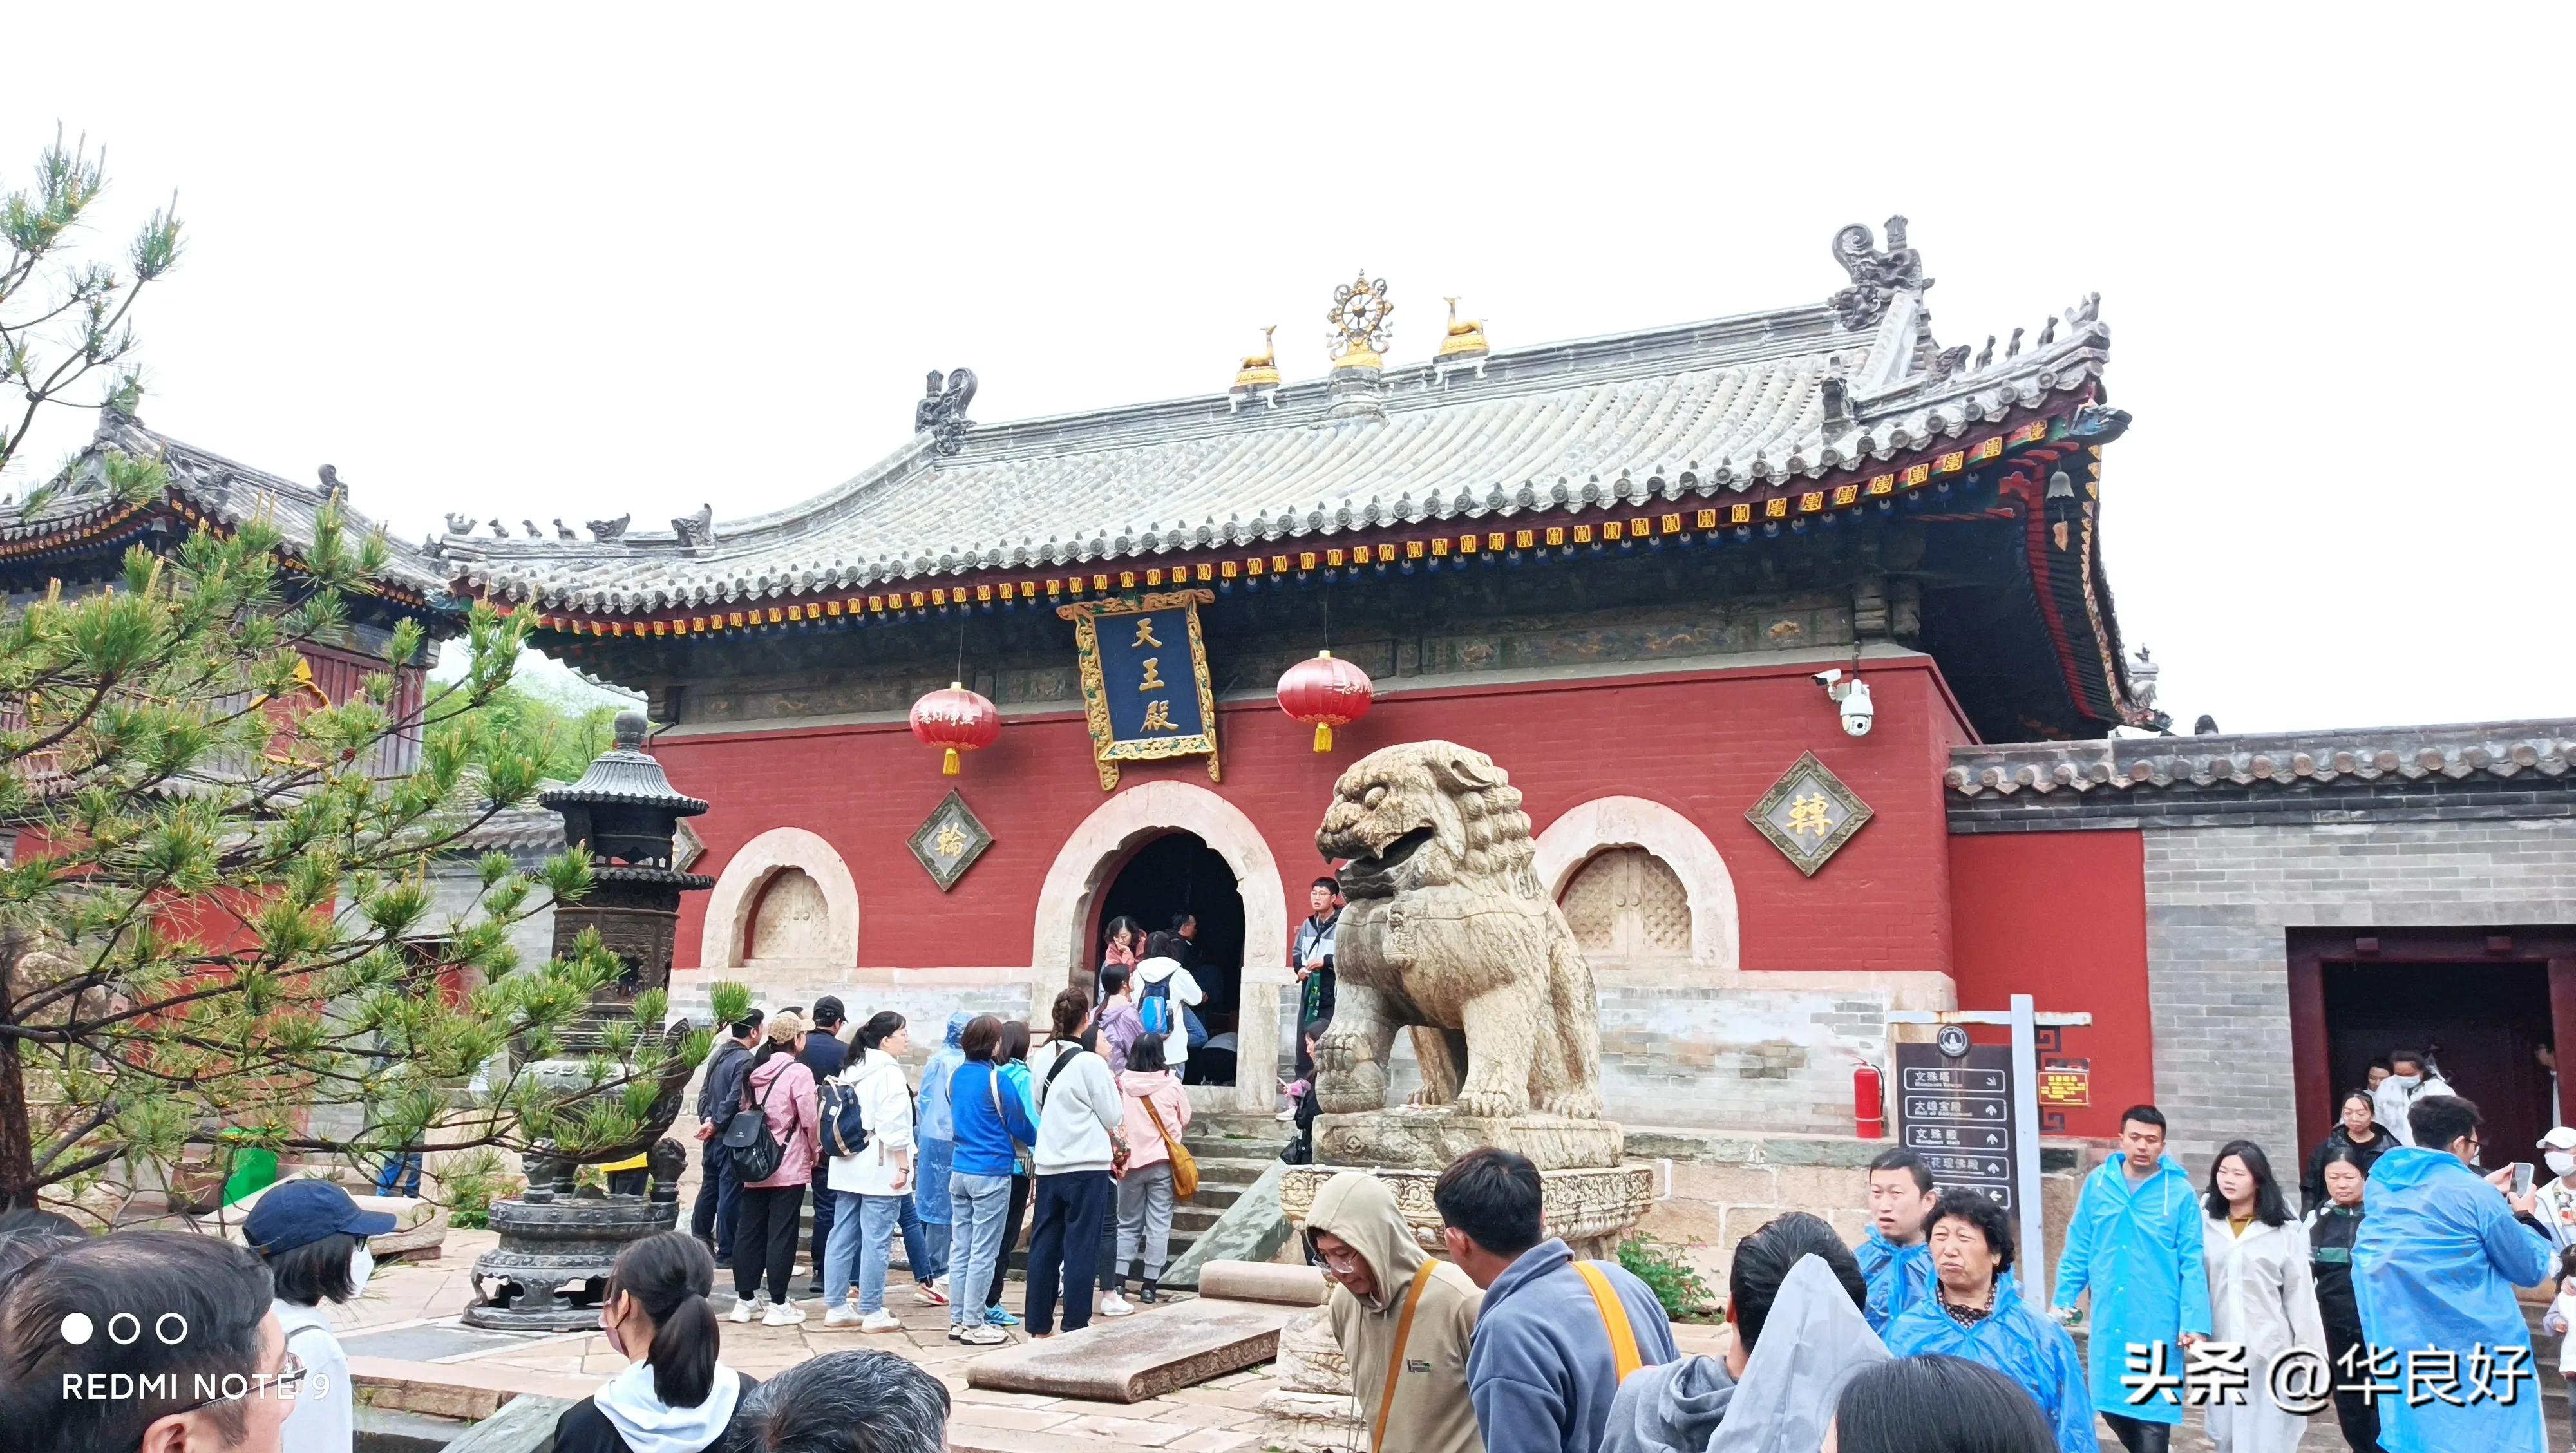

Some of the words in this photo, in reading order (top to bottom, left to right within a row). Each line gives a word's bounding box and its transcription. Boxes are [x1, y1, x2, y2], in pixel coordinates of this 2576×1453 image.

[1131, 618, 1179, 733] 天王殿
[1786, 792, 1833, 837] 轉
[934, 822, 967, 857] 輪
[1915, 1071, 1950, 1082] 文殊塔
[1915, 1100, 1962, 1112] 大雄宝殿
[1915, 1128, 1957, 1139] 文殊殿
